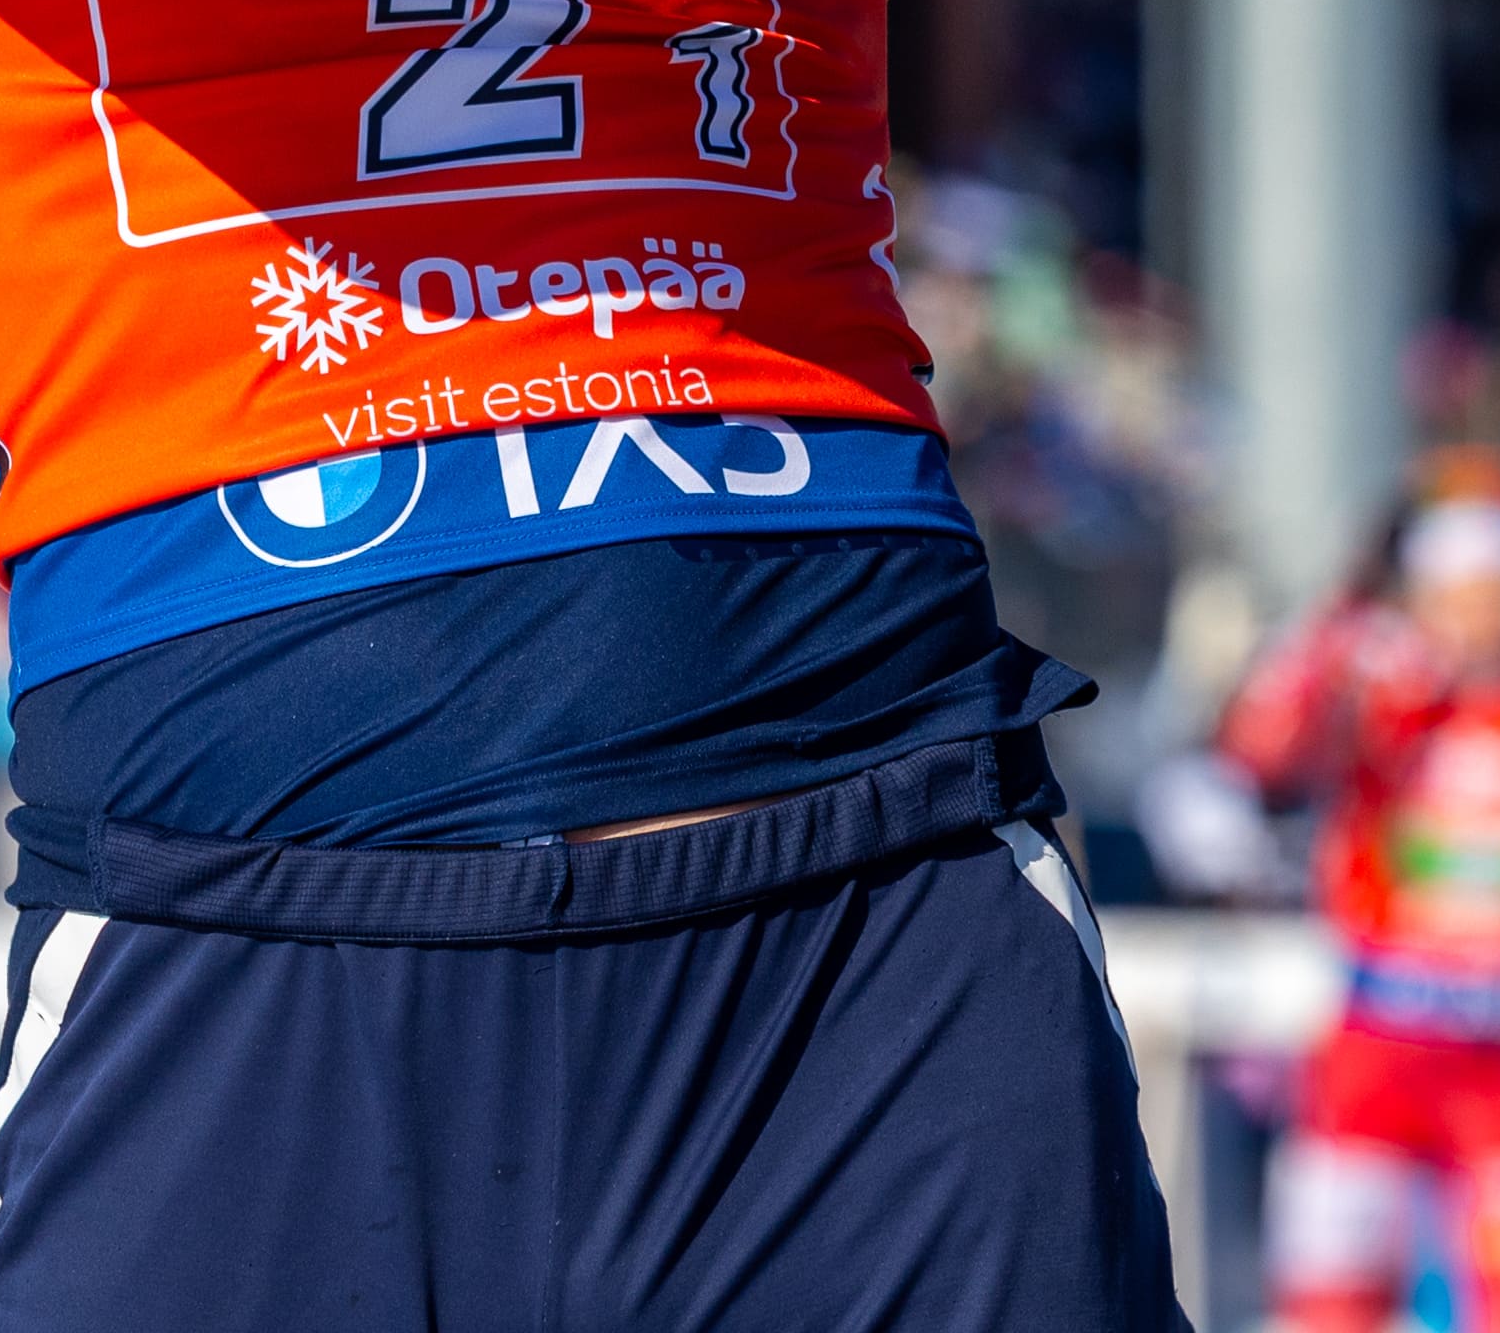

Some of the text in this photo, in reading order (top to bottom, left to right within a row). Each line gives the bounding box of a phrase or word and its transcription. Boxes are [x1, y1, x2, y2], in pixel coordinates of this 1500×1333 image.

[664, 21, 763, 168] 1
[400, 237, 746, 339] Otepää
[322, 354, 714, 448] visit estonia
